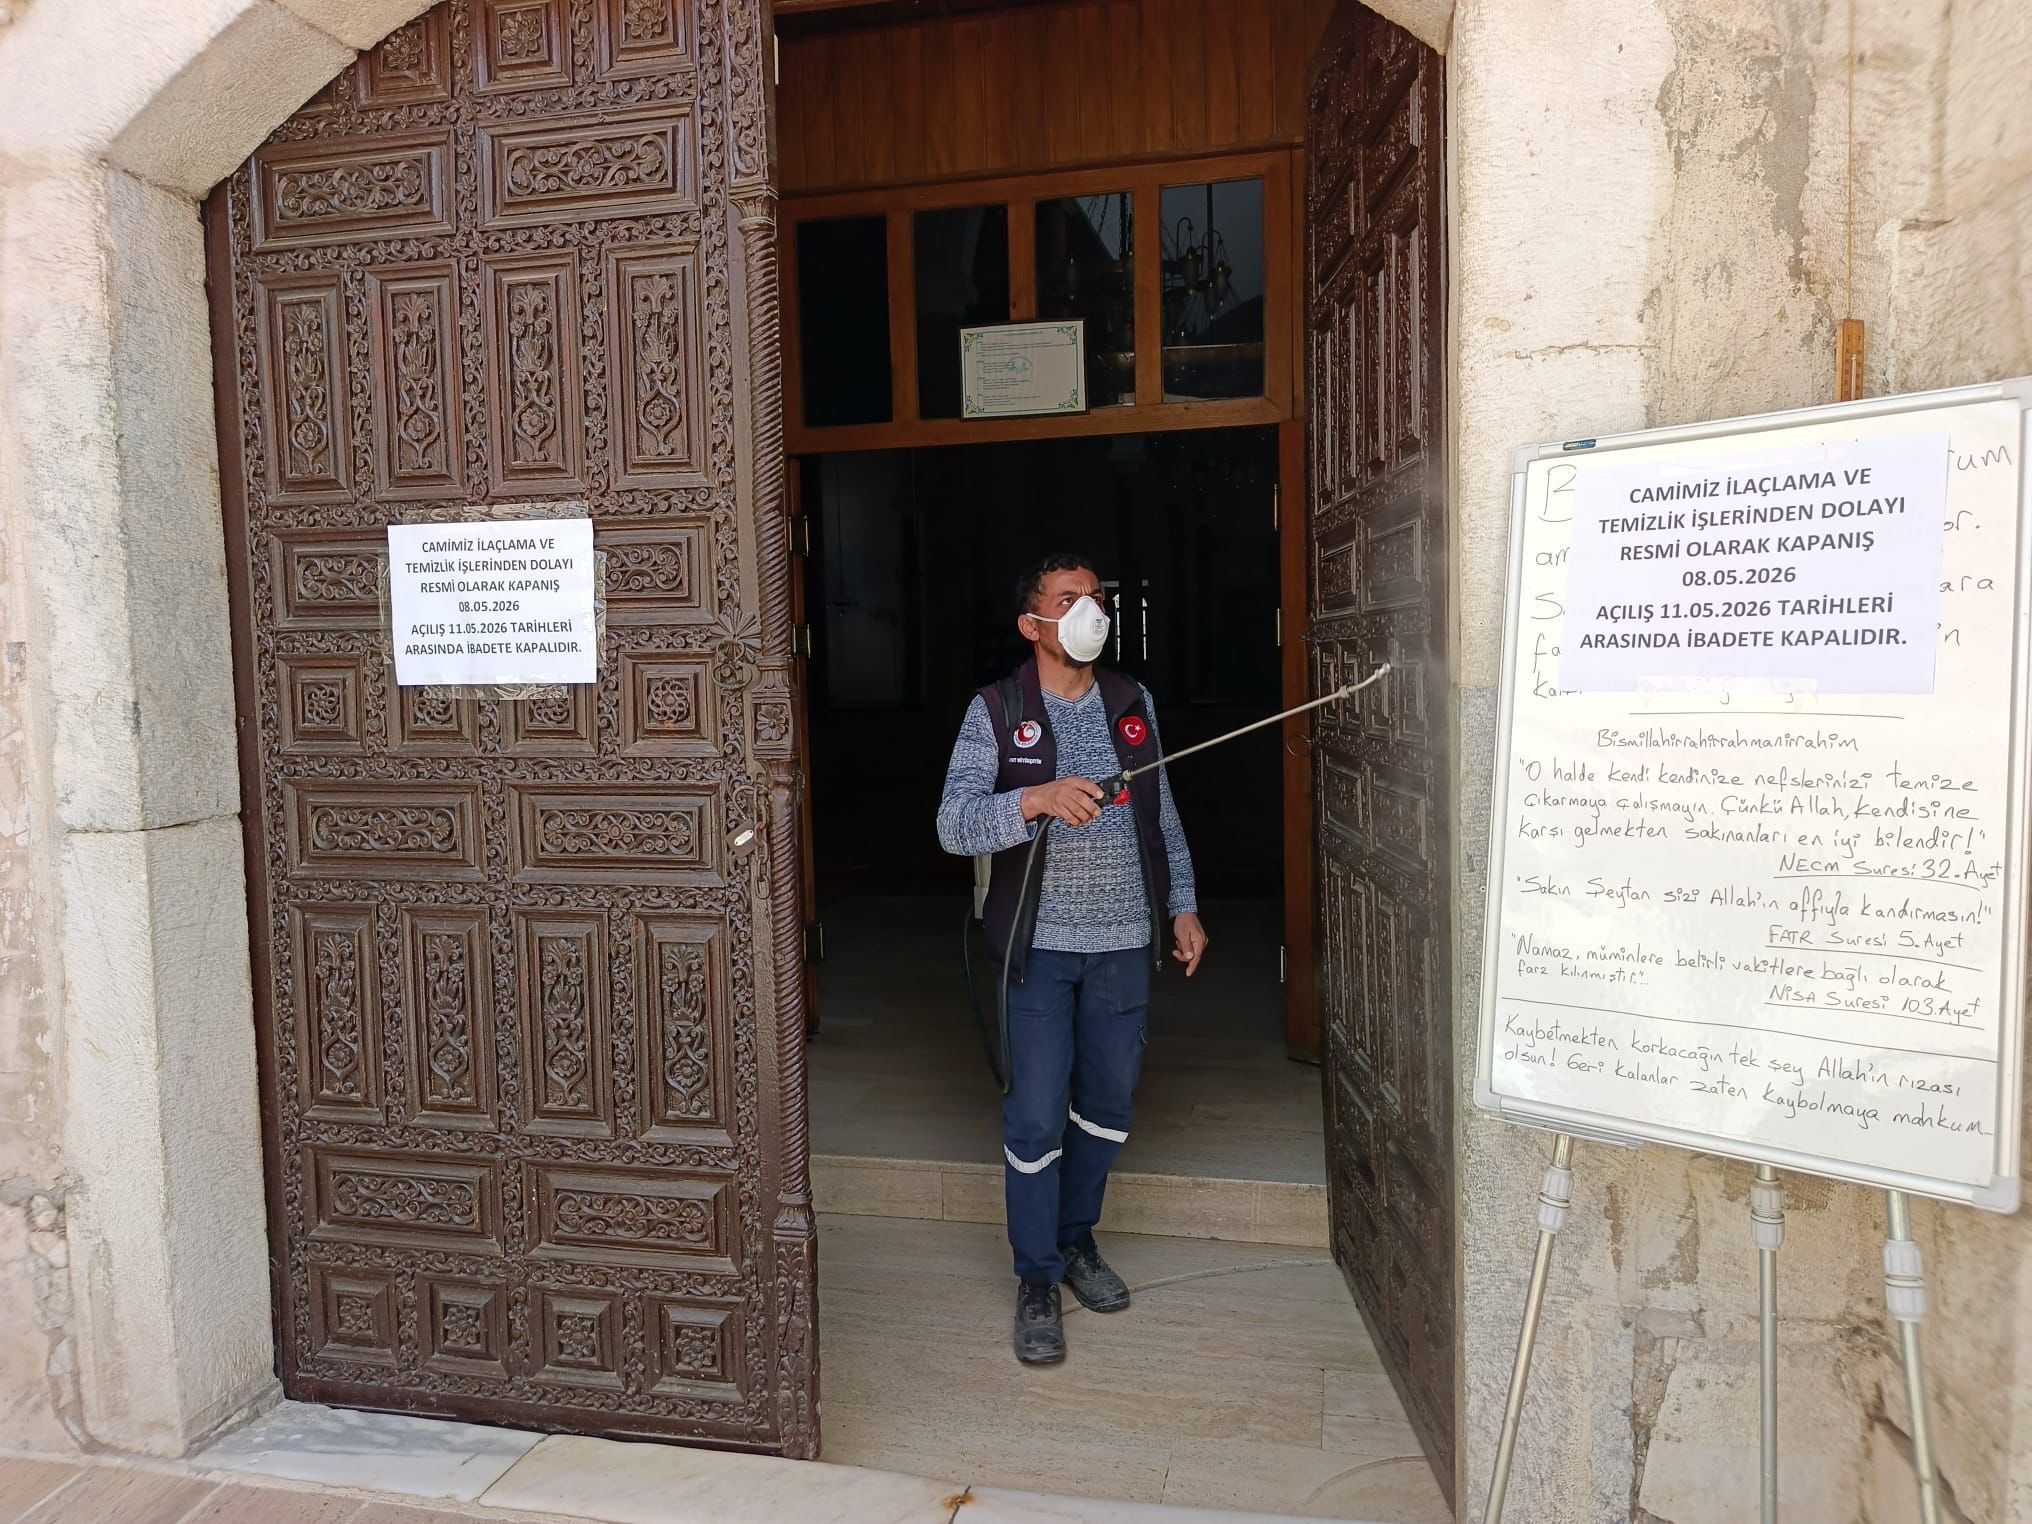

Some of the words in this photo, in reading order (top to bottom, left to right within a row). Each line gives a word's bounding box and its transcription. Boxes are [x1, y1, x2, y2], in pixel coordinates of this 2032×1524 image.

[1629, 479, 1721, 504] CAMİMİZ
[1726, 472, 1837, 496] İLAÇLAMA
[1843, 467, 1872, 486] VE
[1599, 510, 1686, 534] TEMİZLİK
[1691, 504, 1814, 531] İŞLERİNDEN
[1821, 496, 1905, 519] DOLAYI
[422, 537, 474, 553] CAMİMİZ
[477, 537, 537, 553] İLAÇLAMA
[539, 538, 556, 550] VE
[1620, 539, 1681, 561] RESMİ
[1686, 537, 1771, 558] OLARAK
[1777, 530, 1875, 552] KAPANIŞ
[405, 558, 455, 574] TEMİZLİK
[458, 557, 527, 574] İŞLERİNDEN
[530, 558, 574, 571] DOLAYI
[420, 580, 456, 593] RESMİ
[457, 580, 505, 592] OLARAK
[508, 579, 560, 593] KAPANIŞ
[1682, 566, 1797, 587] 08.05.2026
[458, 600, 520, 612] 08.05.2026
[1596, 603, 1654, 623] AÇILIŞ
[1660, 600, 1771, 619] 11.05.2026
[1777, 591, 1893, 616] TARİHLERİ
[411, 623, 446, 638] AÇILIŞ
[449, 622, 508, 635] 11.05.2026
[510, 618, 573, 634] TARİHLERİ
[1579, 632, 1681, 649] ARASINDA
[1687, 628, 1775, 648] İBADETE
[1781, 627, 1908, 647] KAPALIDIR.
[405, 643, 464, 656] ARASINDA
[467, 641, 513, 655] İBADETE
[516, 641, 582, 654] KAPALIDIR.
[1553, 756, 1596, 783] halde
[1658, 762, 1745, 787] kendinize
[1886, 759, 1979, 792] temize
[1574, 816, 1669, 848] gelmekten
[1684, 820, 1787, 843] sakınanları
[1797, 834, 1824, 847] en
[1833, 828, 1862, 859] iyi
[1852, 859, 1917, 877] Suresi
[1585, 876, 1651, 909] Şeytan
[1663, 887, 1701, 904] sizi
[1825, 930, 1888, 947] Suresi
[1516, 958, 1549, 978] farz
[1586, 941, 1664, 967] müminlere
[1674, 948, 1727, 971] belirli
[1731, 955, 1817, 980] vakitlere
[1819, 960, 1868, 990] bağlı
[1878, 963, 1953, 994] olarak
[1825, 991, 1890, 1010] Suresi
[1503, 1012, 1619, 1051] Kaybetmekten
[1631, 1029, 1724, 1073] korkacağın
[1729, 1041, 1762, 1068] tek
[1767, 1057, 1805, 1087] şey
[1898, 1074, 1961, 1098] rızası
[1503, 1042, 1557, 1068] olsun!
[1689, 1074, 1749, 1101] zaten
[1761, 1081, 1881, 1130] kaybolmaya
